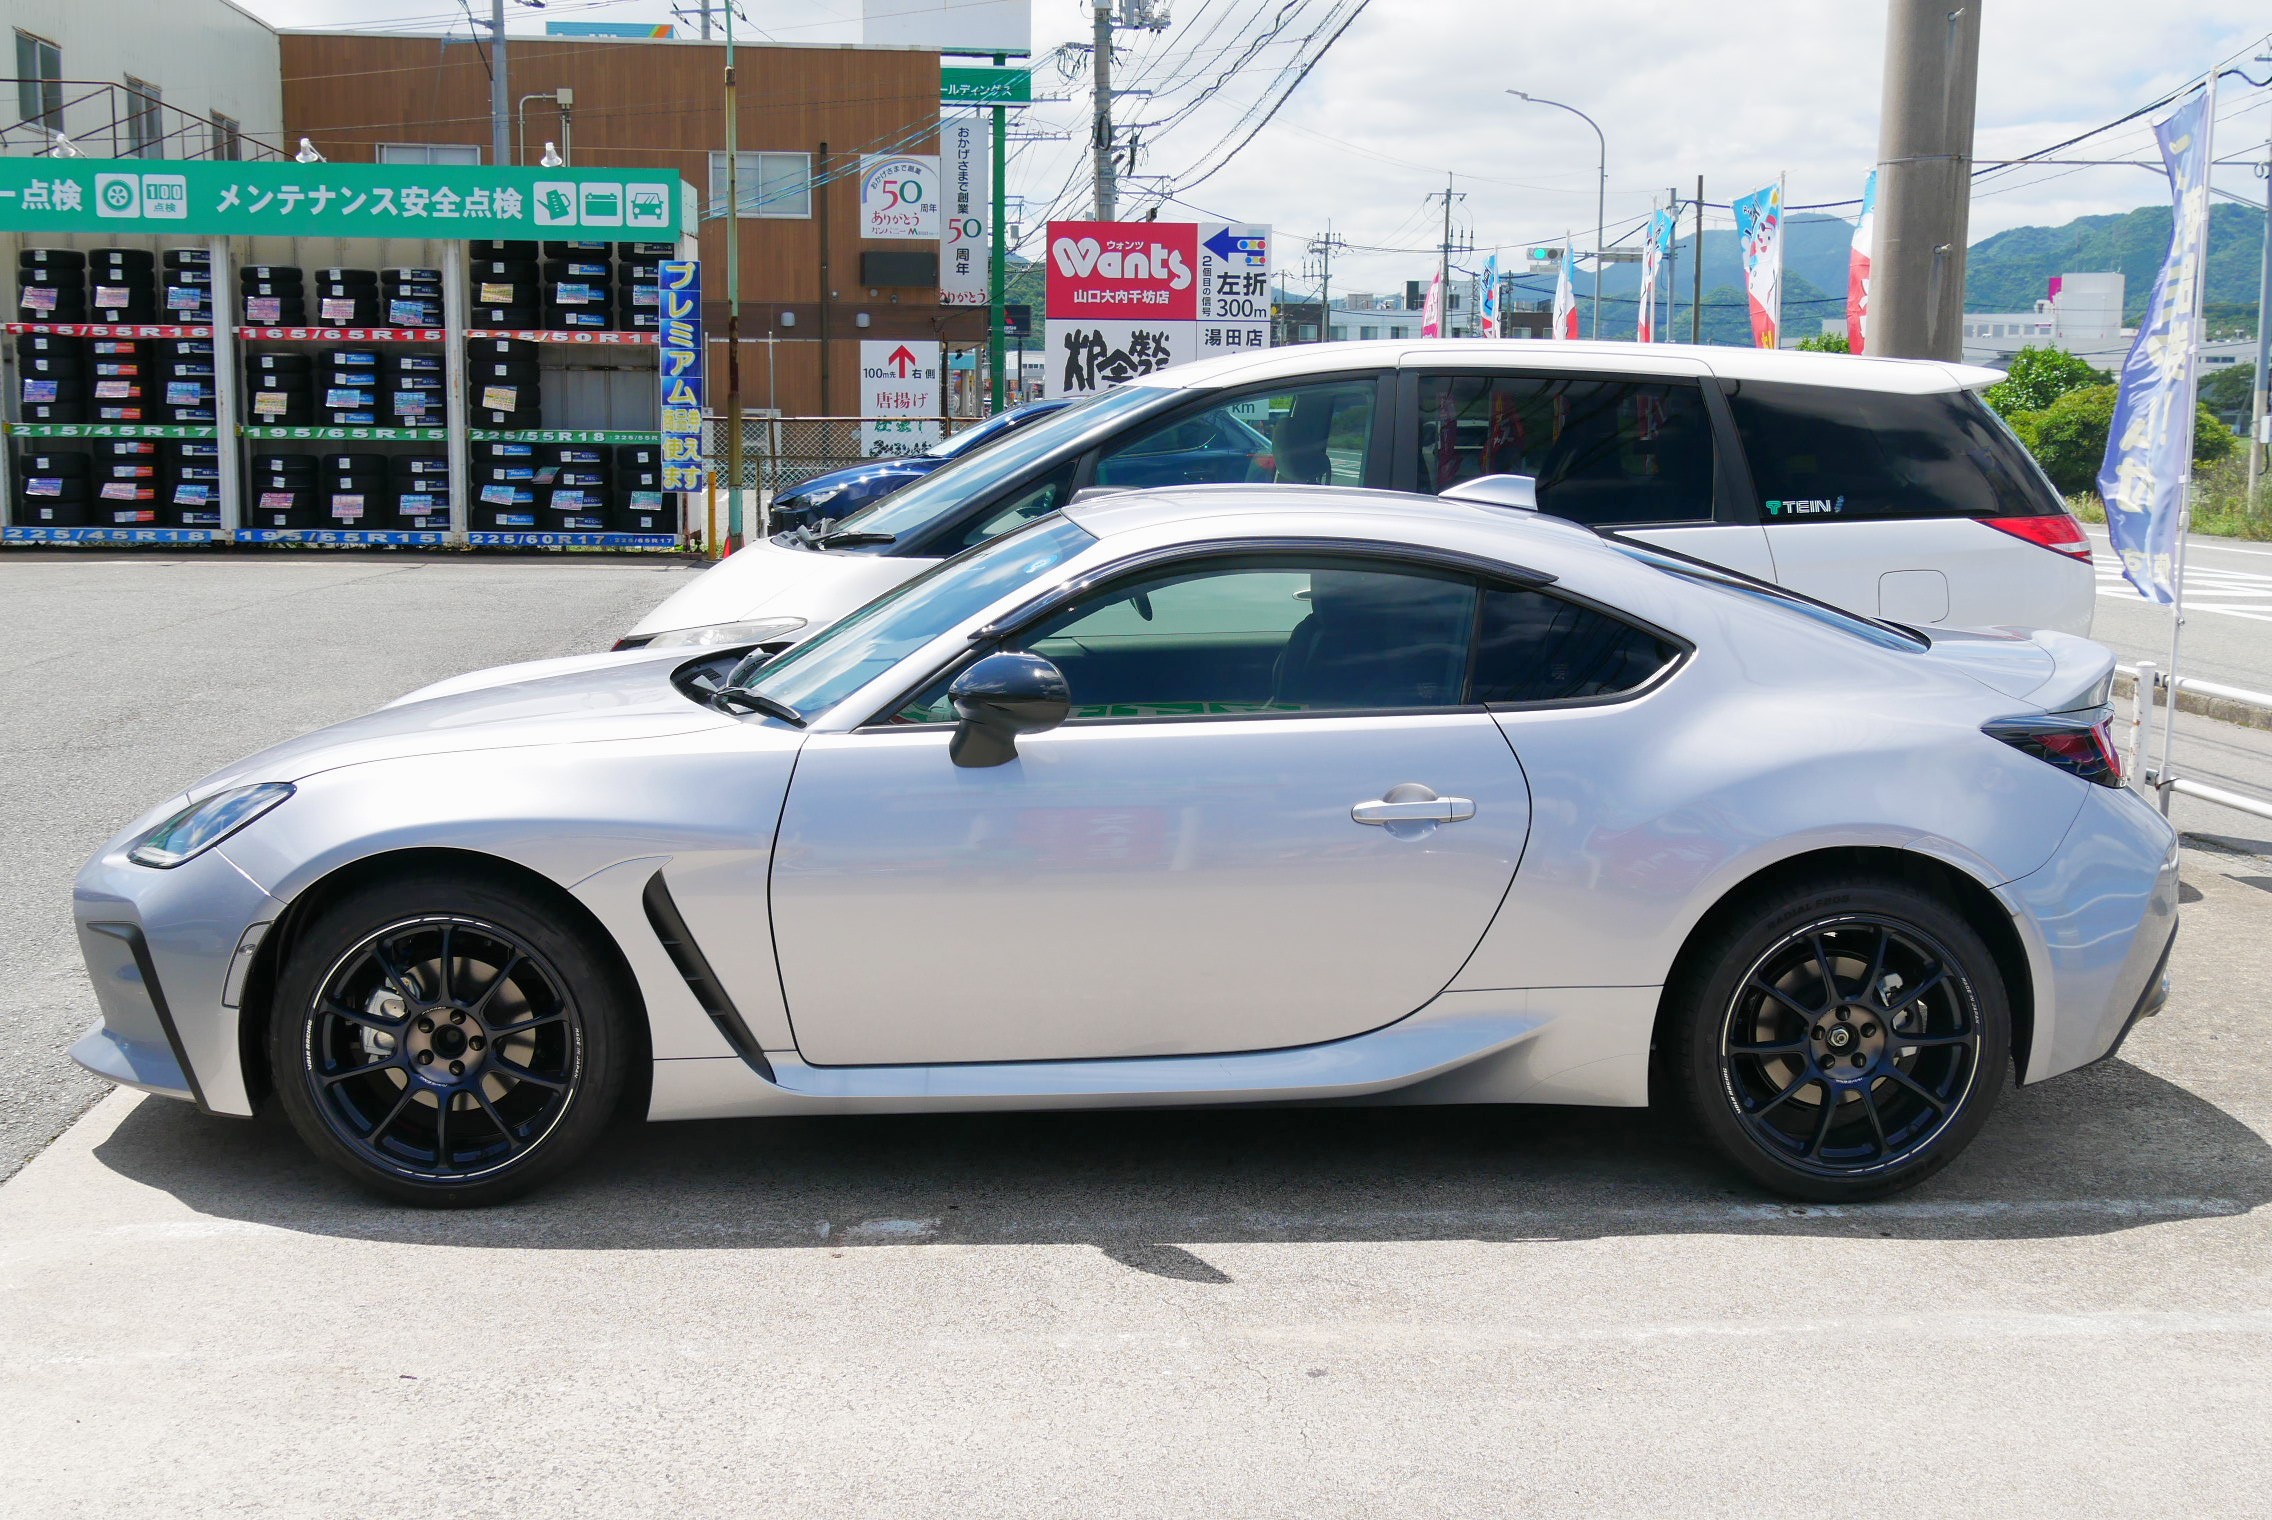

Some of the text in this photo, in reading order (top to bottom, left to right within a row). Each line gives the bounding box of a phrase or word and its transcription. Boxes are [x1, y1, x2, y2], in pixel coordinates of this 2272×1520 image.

[957, 127, 970, 214] おかげさまで創業
[216, 184, 523, 219] メンテナンス安全点検
[881, 179, 923, 211] 50
[153, 202, 176, 213] 点検
[920, 203, 938, 213] 周年
[871, 210, 920, 226] ありがとう
[947, 218, 982, 244] 50
[1106, 240, 1144, 250] ウォンツ
[955, 248, 970, 275] 周年
[1052, 237, 1192, 290] Wants
[1202, 255, 1213, 317] 2個目の信号
[1216, 272, 1268, 297] 左折
[1073, 289, 1170, 304] 山口大内千坊店
[1216, 298, 1267, 318] 300m
[10, 324, 209, 338] 185/55R16
[243, 328, 441, 340] 165/65R15
[664, 261, 698, 406] プレミアム
[1204, 328, 1263, 347] 湯田店
[863, 367, 896, 379] 100m先
[911, 368, 936, 379] 右側
[876, 391, 929, 409] 唐揚げ
[661, 408, 701, 434] 商品券
[13, 425, 213, 437] 215/45R17
[247, 427, 445, 439] 195/65R15
[471, 430, 605, 441] 225/55R18
[661, 437, 701, 462] 使え
[662, 467, 701, 490] ます
[1782, 499, 1832, 514] TEIN
[5, 528, 206, 541] 225/45R18
[471, 534, 605, 545] 225/60R17
